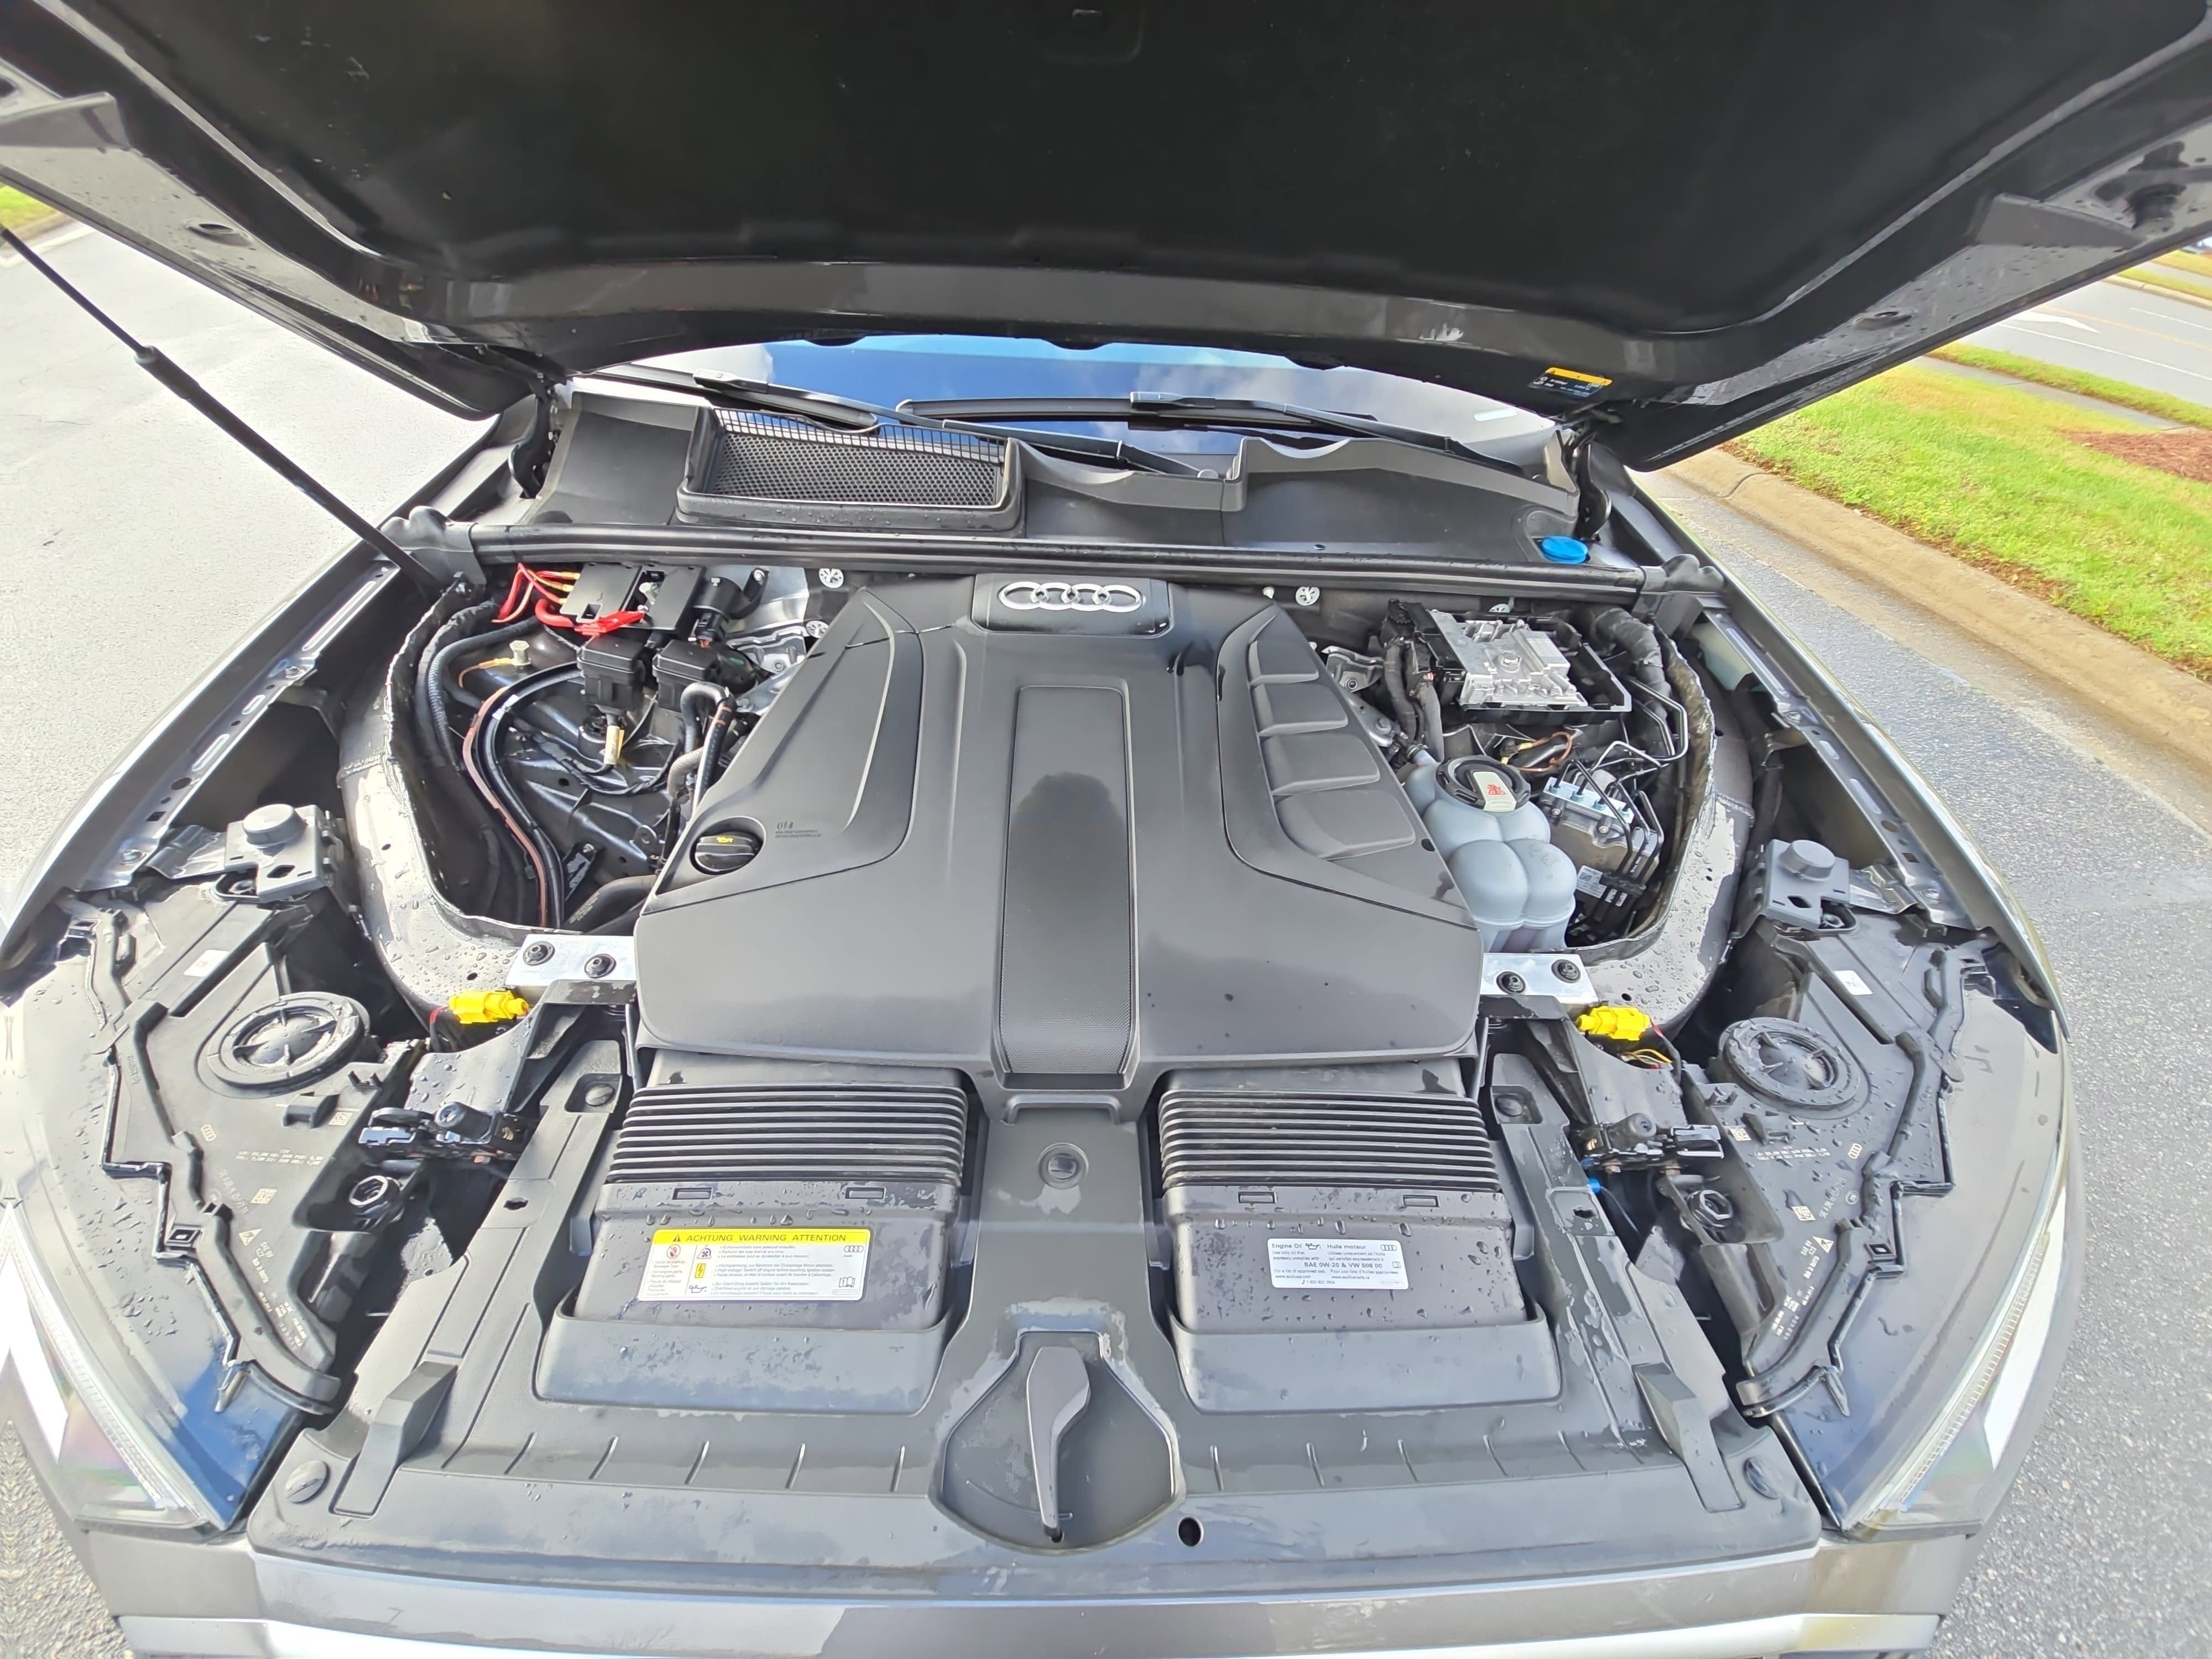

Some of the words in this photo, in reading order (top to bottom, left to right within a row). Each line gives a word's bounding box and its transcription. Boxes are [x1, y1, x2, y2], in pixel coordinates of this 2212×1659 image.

[686, 1234, 733, 1242] ACHTUNG
[739, 1234, 786, 1242] WARNING
[791, 1234, 846, 1242] ATTENTION
